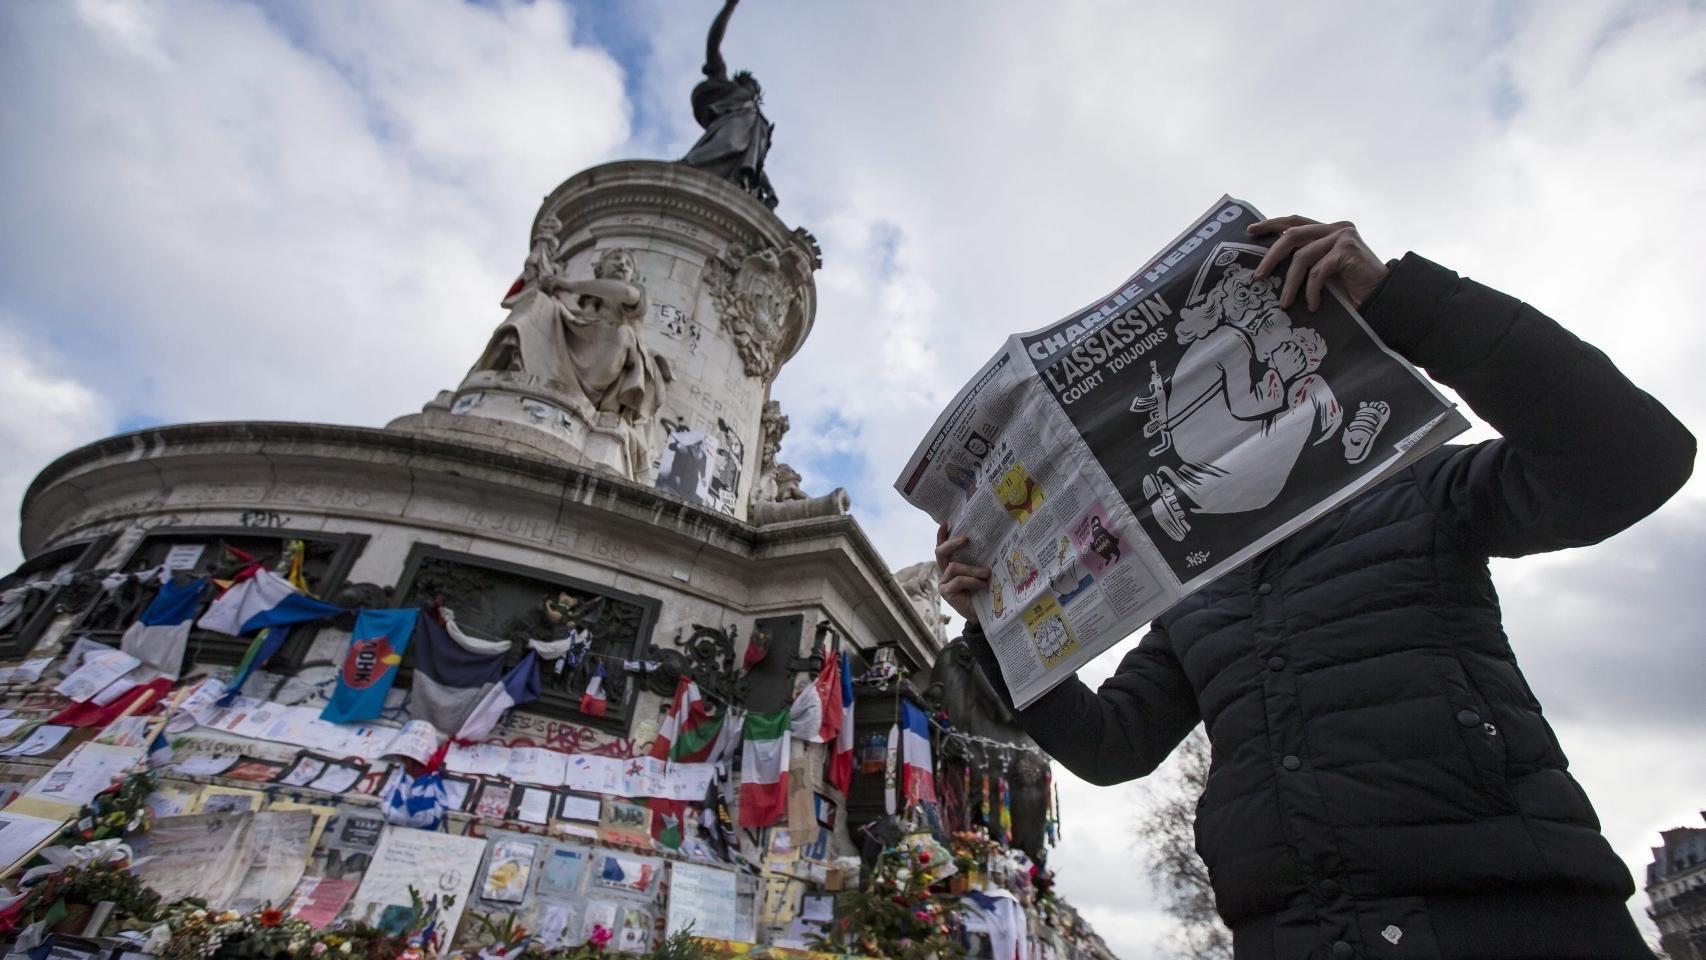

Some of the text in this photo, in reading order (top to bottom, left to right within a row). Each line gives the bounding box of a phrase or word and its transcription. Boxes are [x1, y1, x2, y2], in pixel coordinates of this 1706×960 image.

[1028, 283, 1144, 361] CHARLIE
[1144, 205, 1243, 283] HEBDO
[1041, 292, 1173, 393] L'ASSASSIN
[1062, 372, 1104, 405] COURT
[1106, 327, 1168, 374] TOUJOURS
[931, 433, 946, 452] NOUS
